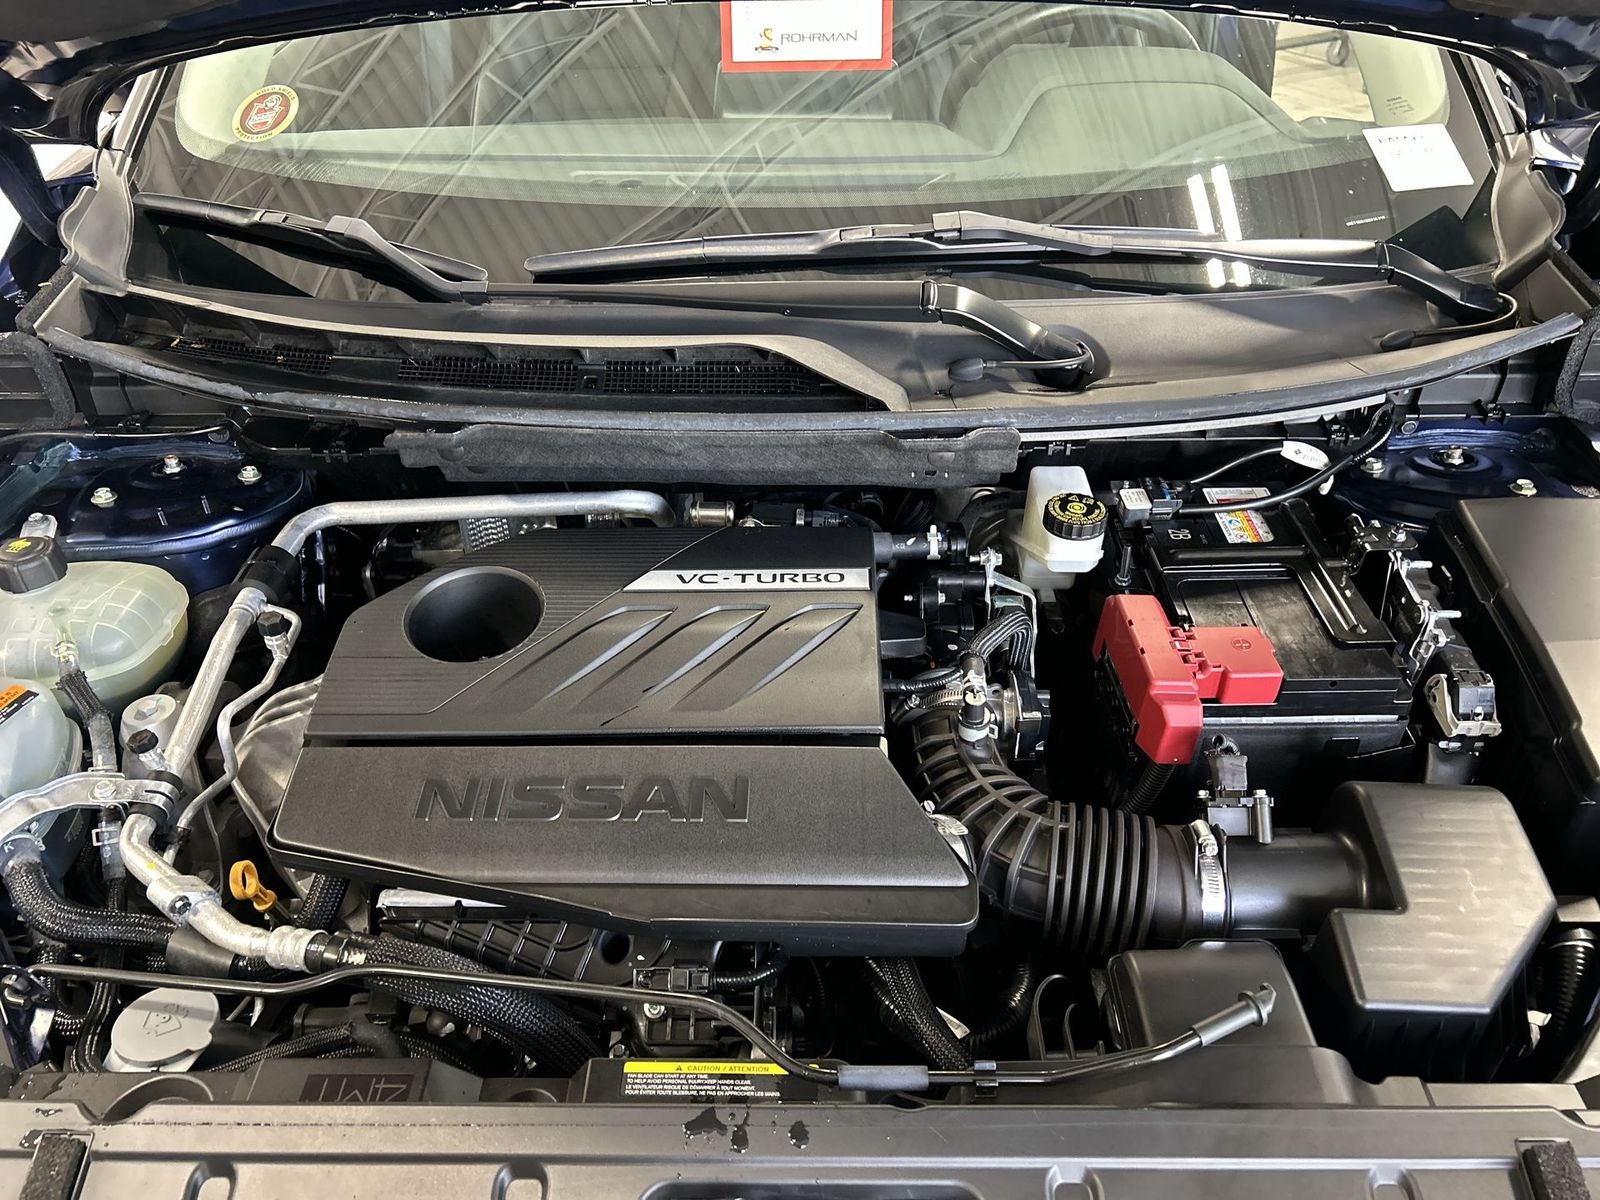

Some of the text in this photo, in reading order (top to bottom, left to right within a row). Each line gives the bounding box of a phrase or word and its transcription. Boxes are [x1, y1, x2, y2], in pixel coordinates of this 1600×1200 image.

[780, 30, 858, 45] ROHRMAN
[235, 127, 273, 140] PROTECTION
[675, 572, 846, 584] VC-TURBO
[413, 776, 750, 822] NISSAN
